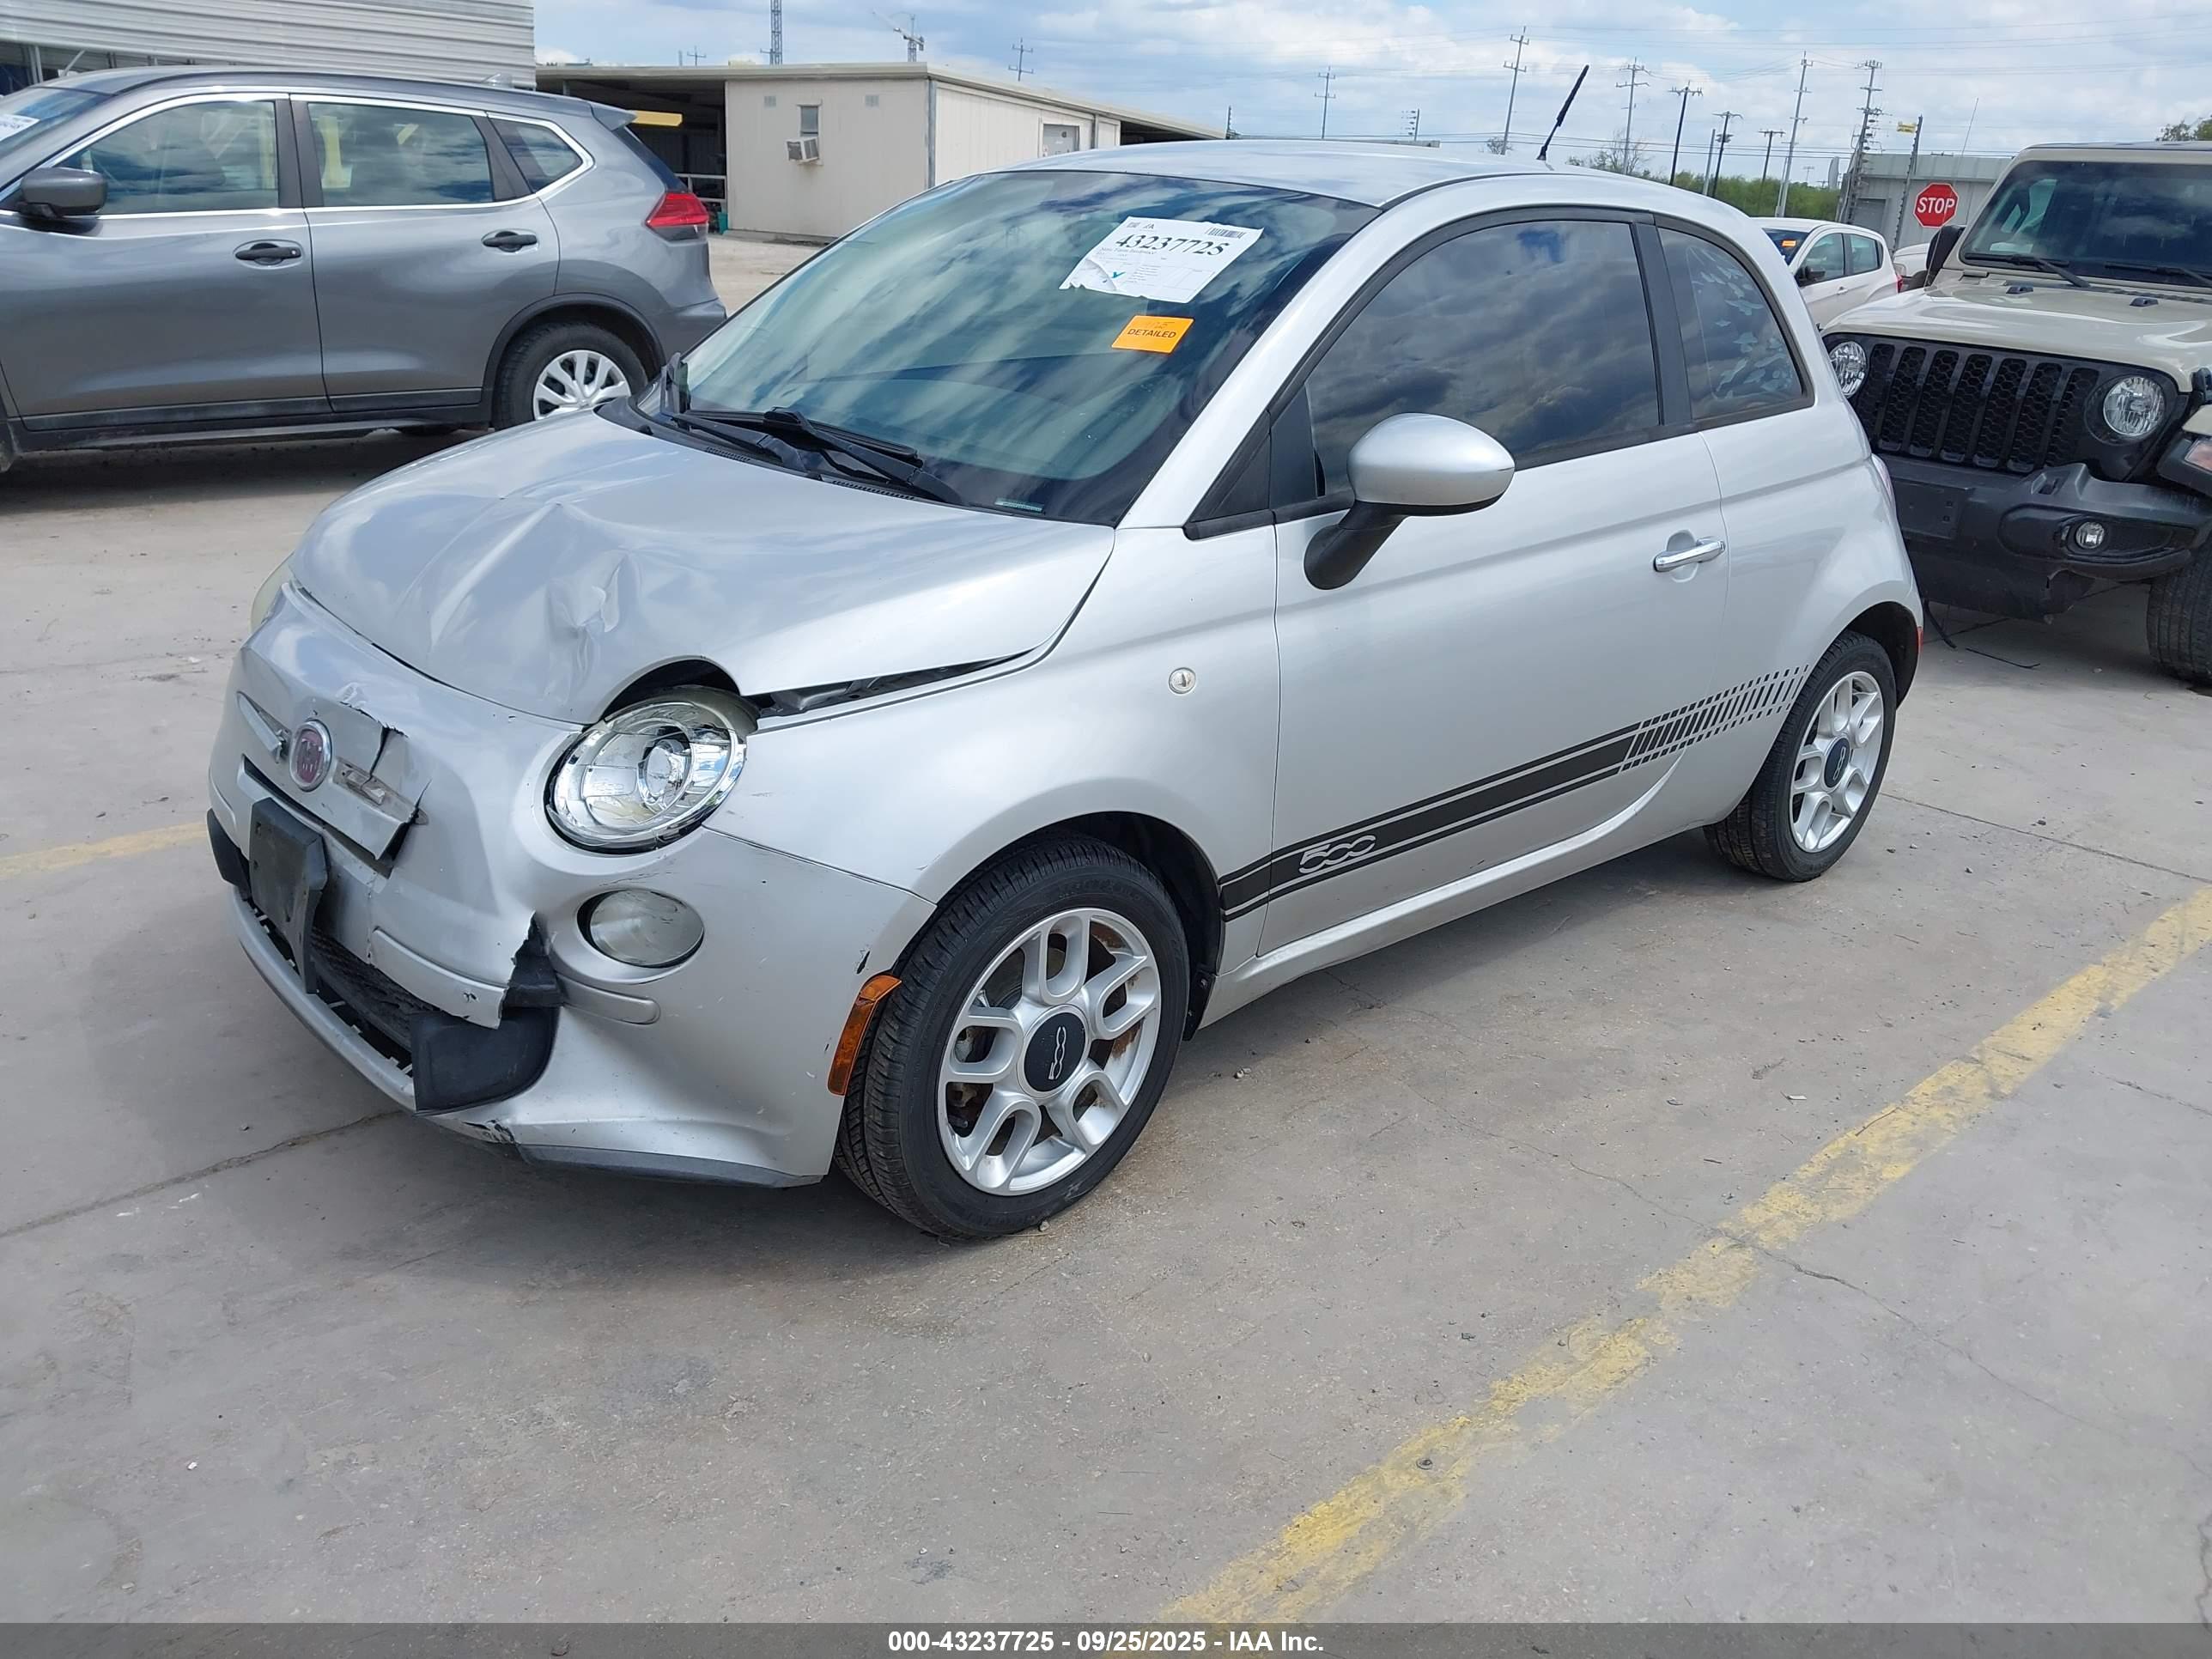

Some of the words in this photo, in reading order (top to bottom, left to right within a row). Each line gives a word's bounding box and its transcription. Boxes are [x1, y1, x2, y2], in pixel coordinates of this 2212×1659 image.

[1917, 197, 1955, 214] STOP
[1115, 234, 1231, 256] 43237725
[1127, 328, 1176, 338] DETAILED
[1298, 835, 1376, 874] 500
[1048, 1026, 1066, 1079] 500
